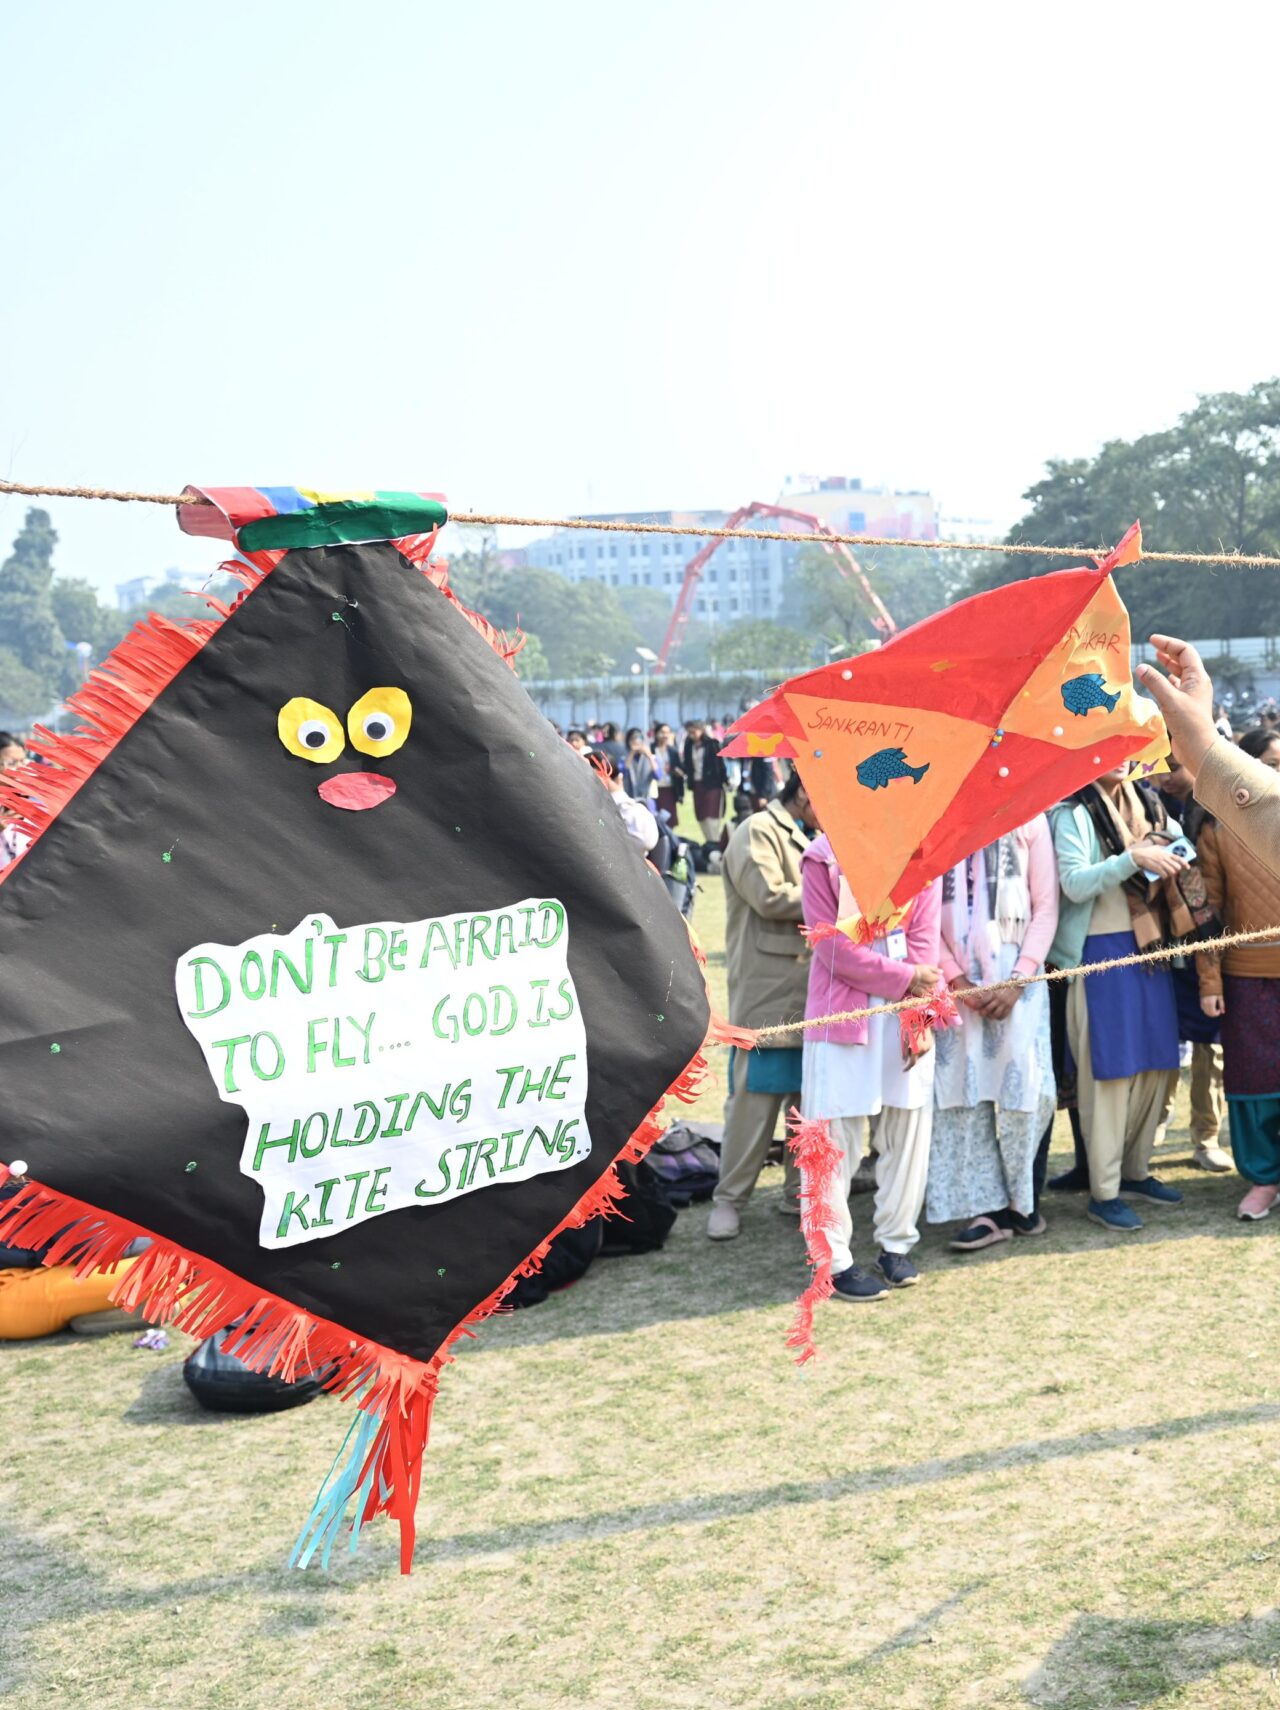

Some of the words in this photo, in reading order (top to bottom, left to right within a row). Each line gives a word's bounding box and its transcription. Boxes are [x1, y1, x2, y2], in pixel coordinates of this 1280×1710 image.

[807, 706, 914, 742] SANKRANTI
[188, 920, 348, 1019] DON'T
[355, 928, 408, 983] BE
[419, 901, 565, 970] AFRAID
[211, 1031, 286, 1093] TO
[432, 984, 518, 1043] GOD
[528, 978, 574, 1027] IS
[252, 1079, 472, 1171] HOLDING
[496, 1054, 576, 1109] THE
[276, 1167, 391, 1238] KITE
